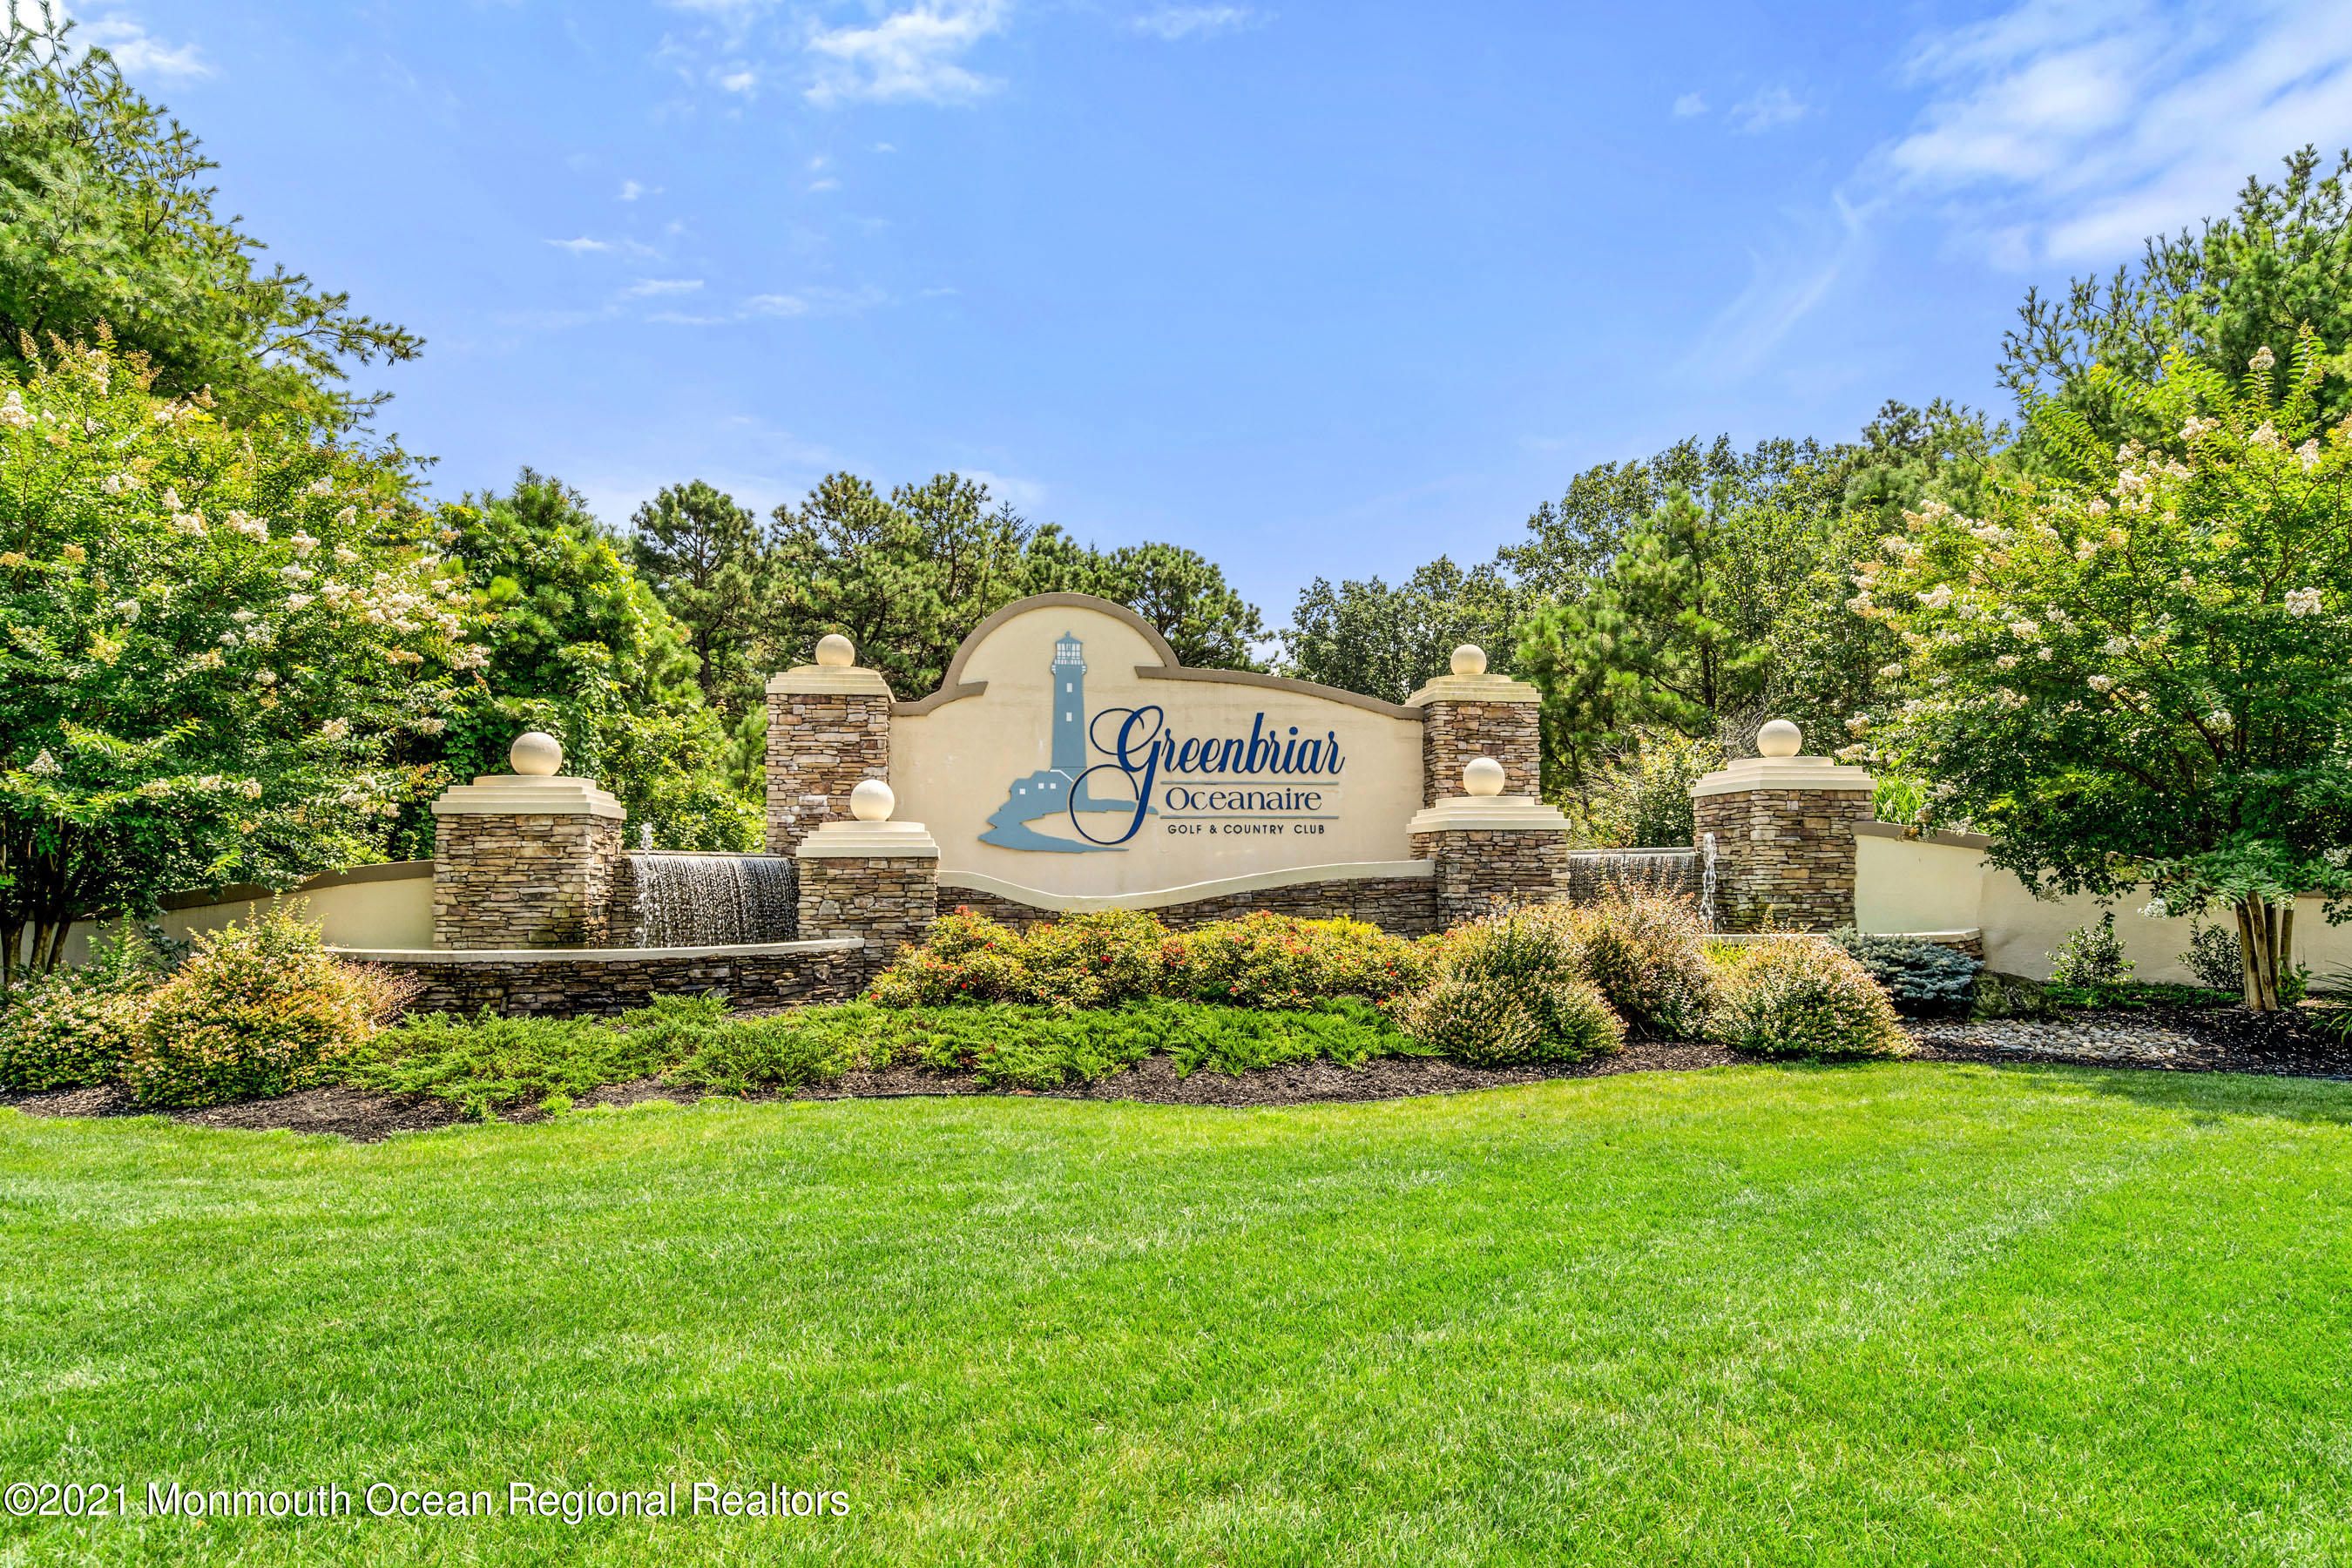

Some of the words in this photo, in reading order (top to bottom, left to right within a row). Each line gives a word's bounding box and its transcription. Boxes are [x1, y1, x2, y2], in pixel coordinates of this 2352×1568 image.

[1069, 705, 1346, 845] Greenbriar
[1166, 787, 1322, 811] Oceanaire
[1167, 824, 1202, 835] GOLF
[1209, 824, 1217, 835] &
[1223, 824, 1284, 835] COUNTRY
[1294, 824, 1325, 835] CLUB
